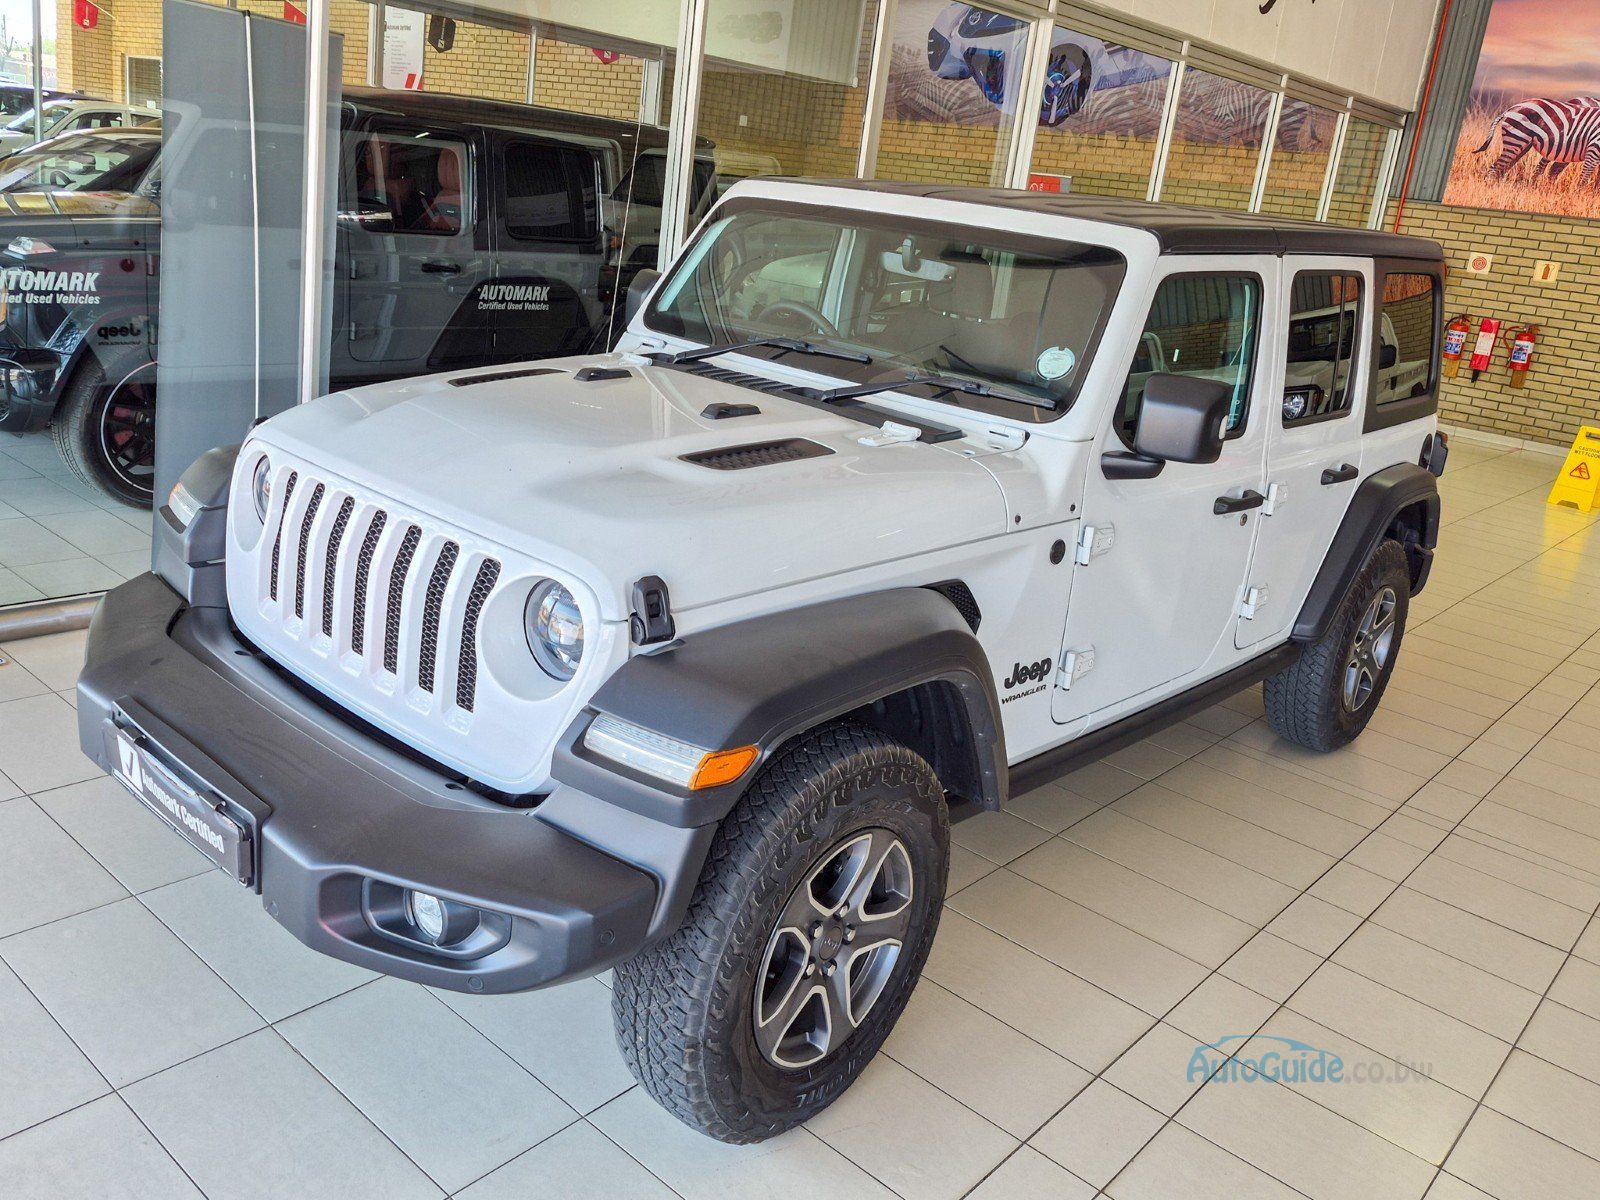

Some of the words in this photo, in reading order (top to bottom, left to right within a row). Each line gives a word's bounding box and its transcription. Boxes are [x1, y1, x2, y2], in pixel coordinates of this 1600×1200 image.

[25, 293, 53, 304] Used
[56, 294, 101, 304] Vehicles
[479, 285, 550, 301] AUTOMARK
[477, 301, 506, 310] Certified
[507, 302, 523, 310] Used
[524, 302, 550, 310] Vehicles
[1004, 657, 1052, 689] Jeep
[1001, 684, 1046, 704] WRANGLER
[180, 805, 225, 854] Certified
